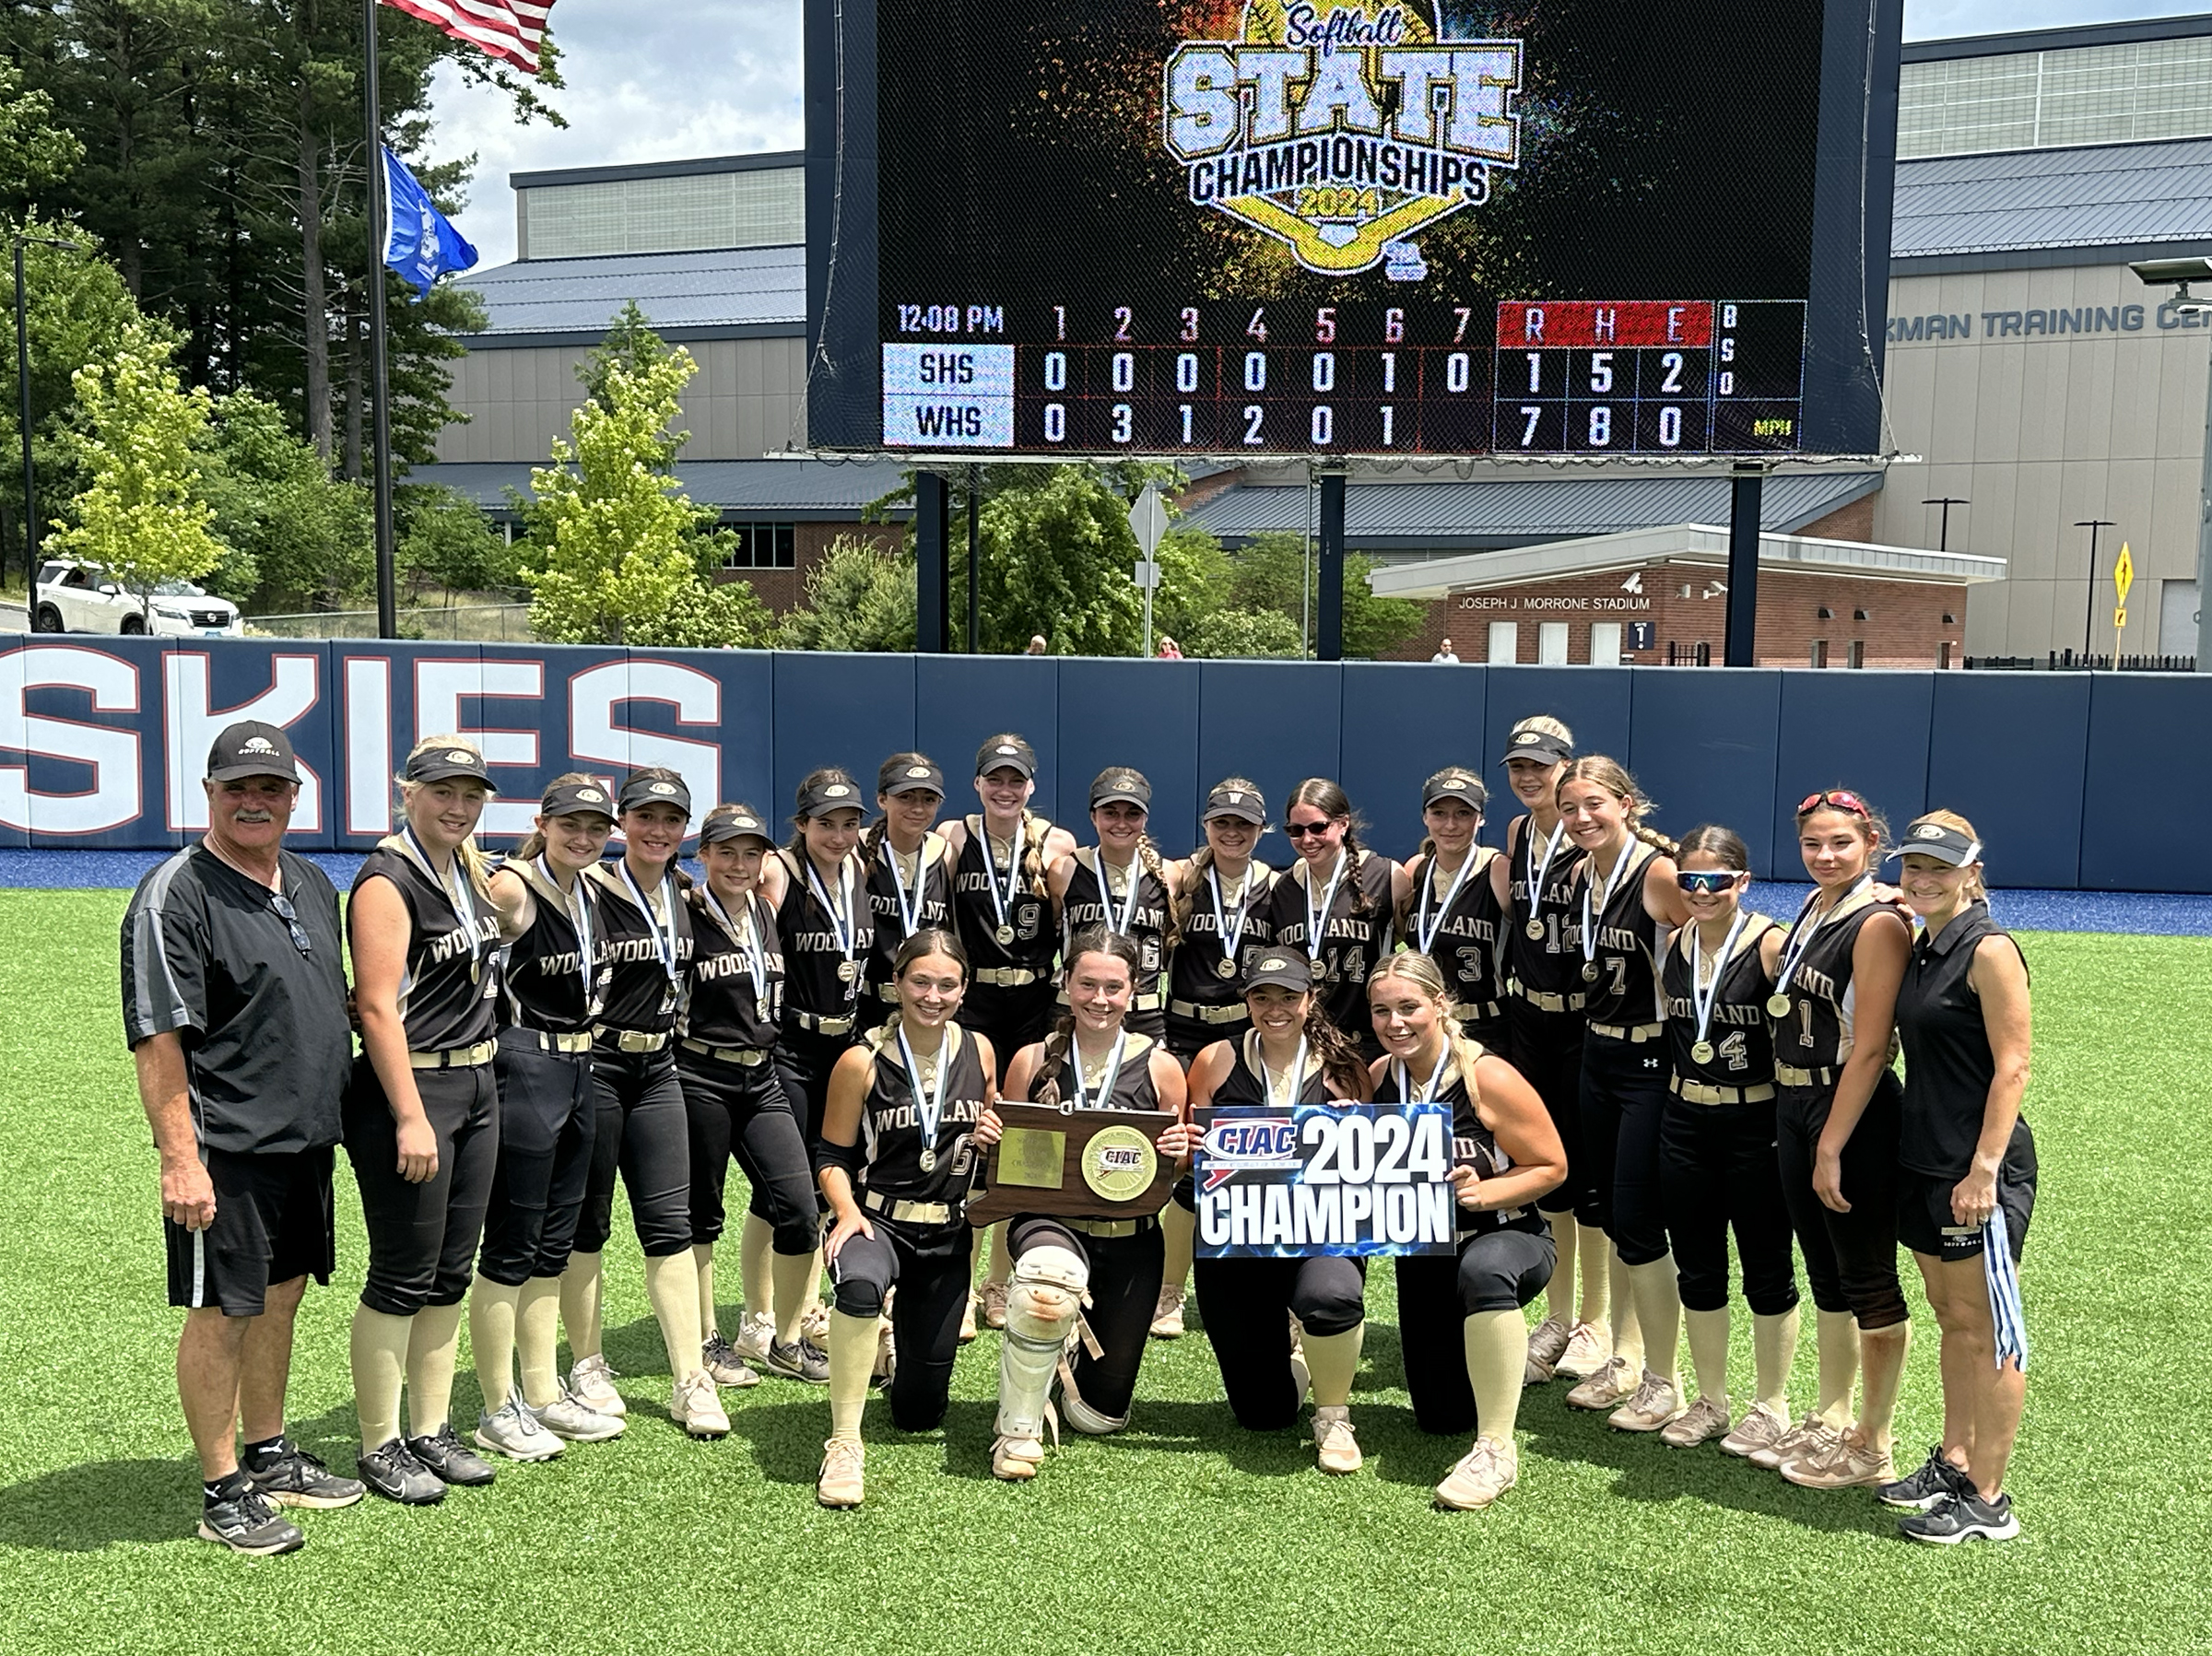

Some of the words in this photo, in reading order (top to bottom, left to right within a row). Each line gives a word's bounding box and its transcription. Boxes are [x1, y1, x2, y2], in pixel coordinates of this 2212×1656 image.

[1287, 6, 1402, 55] Softball
[1167, 45, 1519, 159] STATE
[1195, 135, 1488, 201] CHAMPIONSHIPS
[1298, 188, 1378, 217] 2024
[967, 305, 1003, 333] PM
[1054, 307, 1065, 341] 1
[1114, 306, 1132, 342] 2
[1181, 307, 1199, 343] 3
[1247, 308, 1267, 343] 4
[1315, 309, 1335, 344] 5
[1385, 308, 1404, 343] 6
[1453, 308, 1471, 343] 7
[1526, 309, 1544, 342] R
[1596, 308, 1615, 342] H
[1668, 308, 1685, 342] E
[1981, 304, 2145, 337] TRAINING
[921, 354, 973, 383] SHS
[1044, 352, 1065, 392] 0
[1112, 352, 1134, 392] 0
[1177, 353, 1197, 392] 0
[1245, 353, 1265, 392] 0
[1313, 352, 1334, 392] 0
[1381, 352, 1394, 393] 1
[1447, 353, 1469, 393] 0
[1527, 353, 1540, 393] 1
[1591, 353, 1613, 393] 5
[1662, 353, 1683, 393] 2
[916, 406, 981, 437] WHS
[1044, 404, 1065, 442] 0
[1112, 405, 1132, 443] 3
[1180, 405, 1192, 443] 1
[1243, 405, 1264, 444] 2
[1312, 406, 1333, 444] 0
[1381, 406, 1394, 445] 1
[1521, 407, 1541, 446] 7
[1589, 407, 1611, 446] 8
[1660, 407, 1682, 447] 0
[1753, 419, 1792, 436] MPH
[1459, 598, 1507, 609] JOSEPH
[1524, 598, 1589, 610] MORRONE
[1593, 597, 1650, 610] STADIUM
[1018, 903, 1041, 941] 9
[1326, 945, 1365, 982] 14
[1456, 946, 1481, 982] 3
[1605, 957, 1627, 995] 7
[1799, 999, 1814, 1049] 1
[1719, 1031, 1748, 1071] 4
[949, 1133, 977, 1176] 6
[1218, 1127, 1296, 1156] CIAC
[1302, 1114, 1448, 1185] 2024
[1200, 1182, 1451, 1246] CHAMPION
